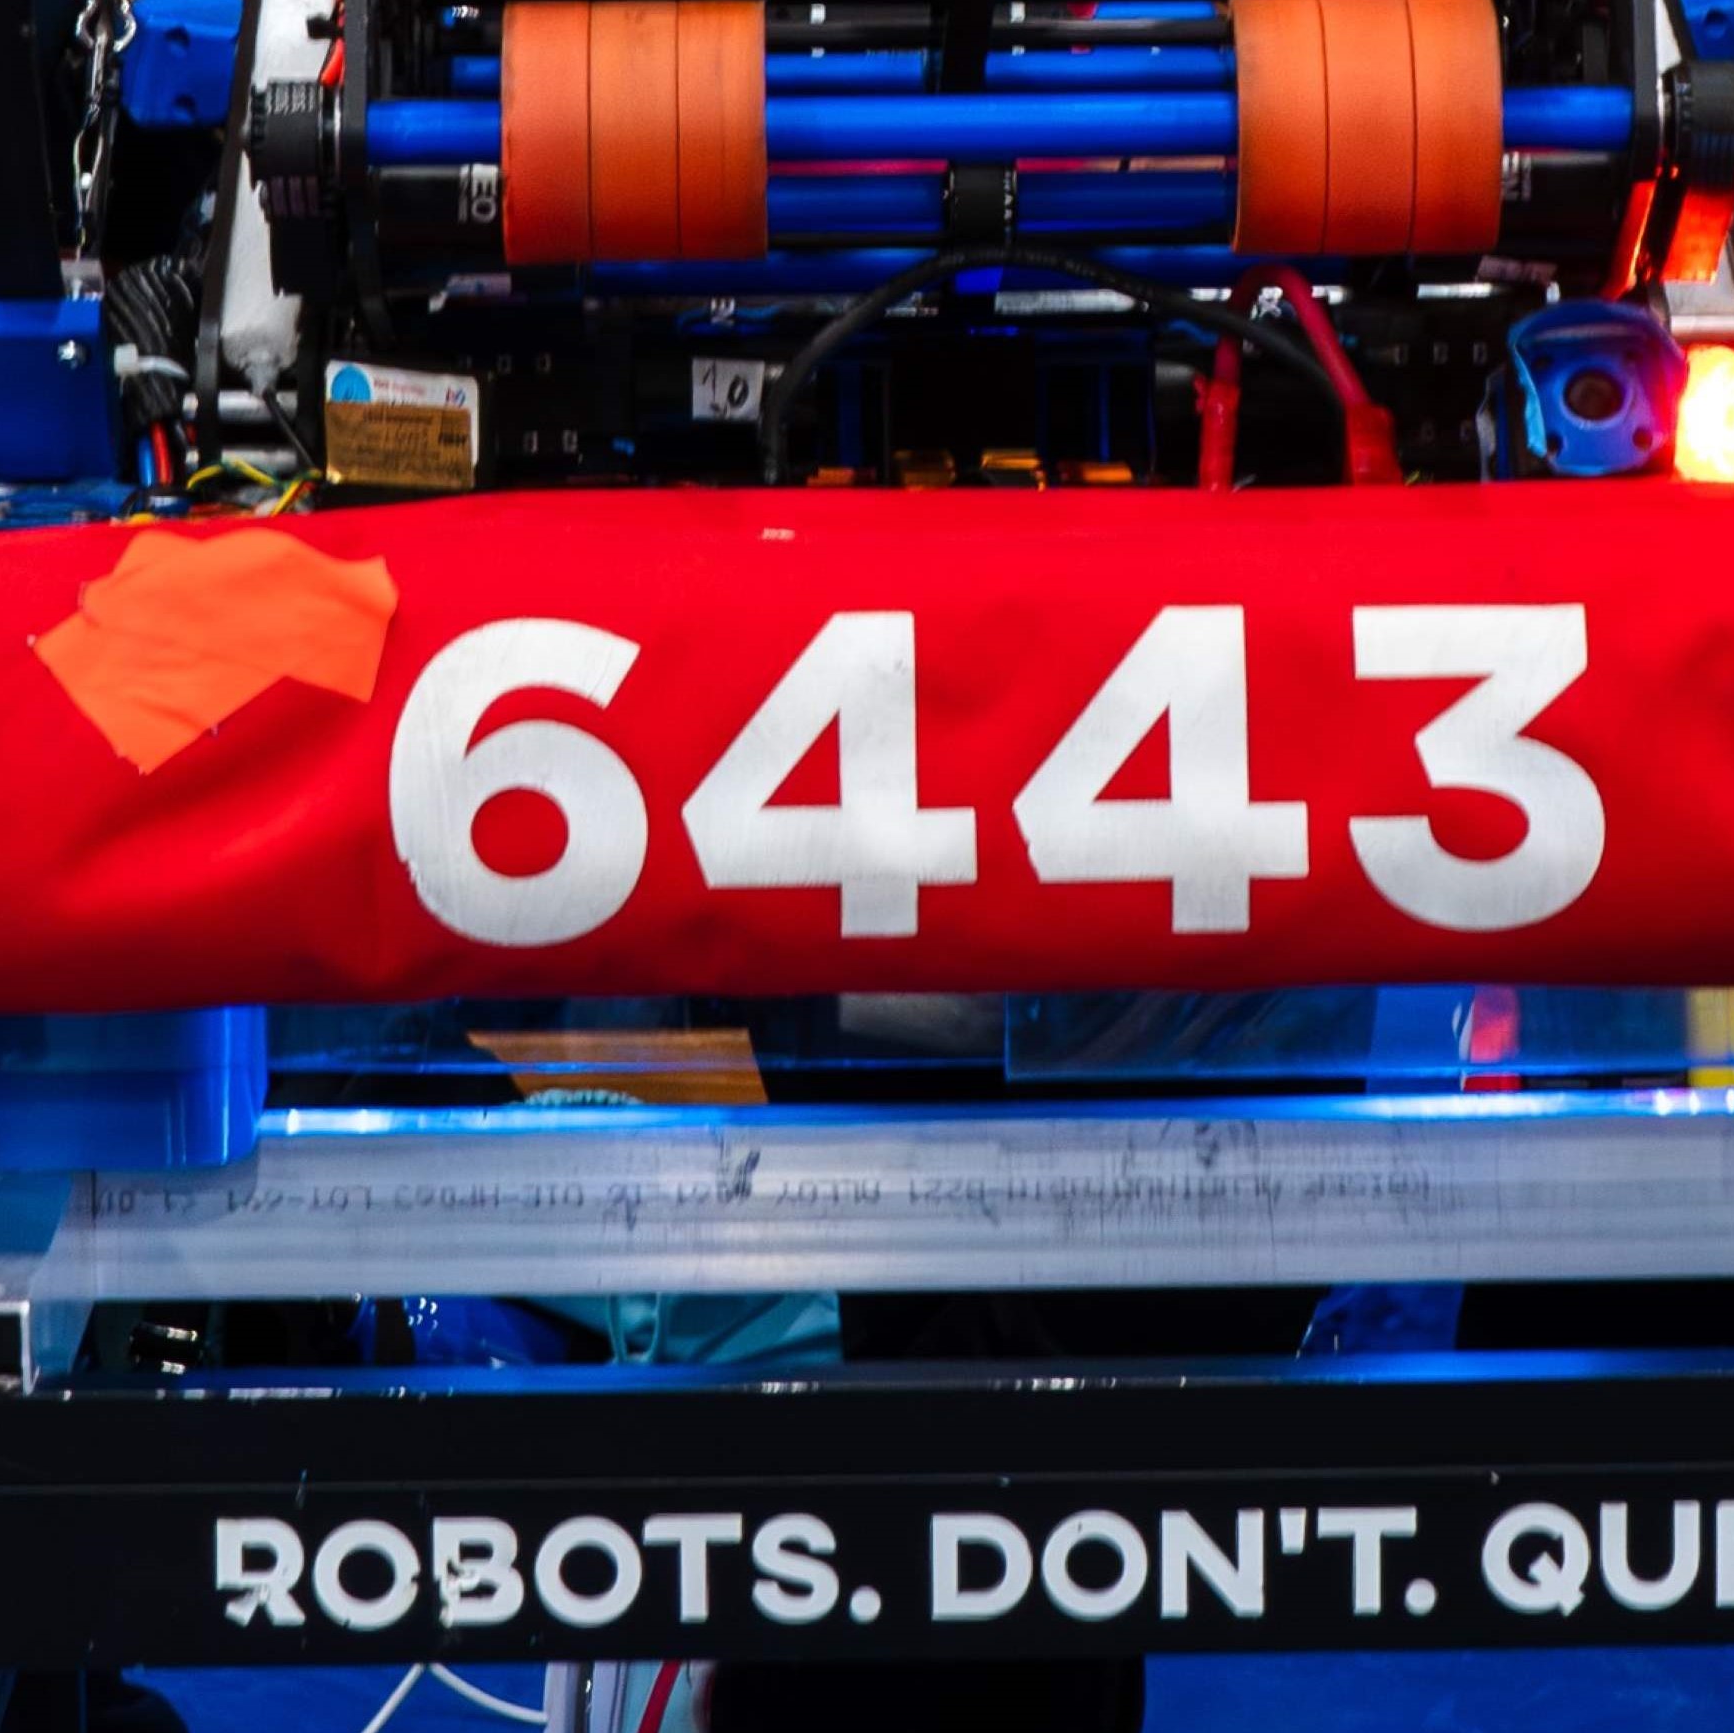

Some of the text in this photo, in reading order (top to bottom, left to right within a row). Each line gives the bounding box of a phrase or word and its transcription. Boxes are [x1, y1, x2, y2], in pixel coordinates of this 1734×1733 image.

[390, 605, 1604, 945] 6443
[217, 1515, 880, 1627] ROBOTS.
[933, 1508, 1435, 1620] DON'T.
